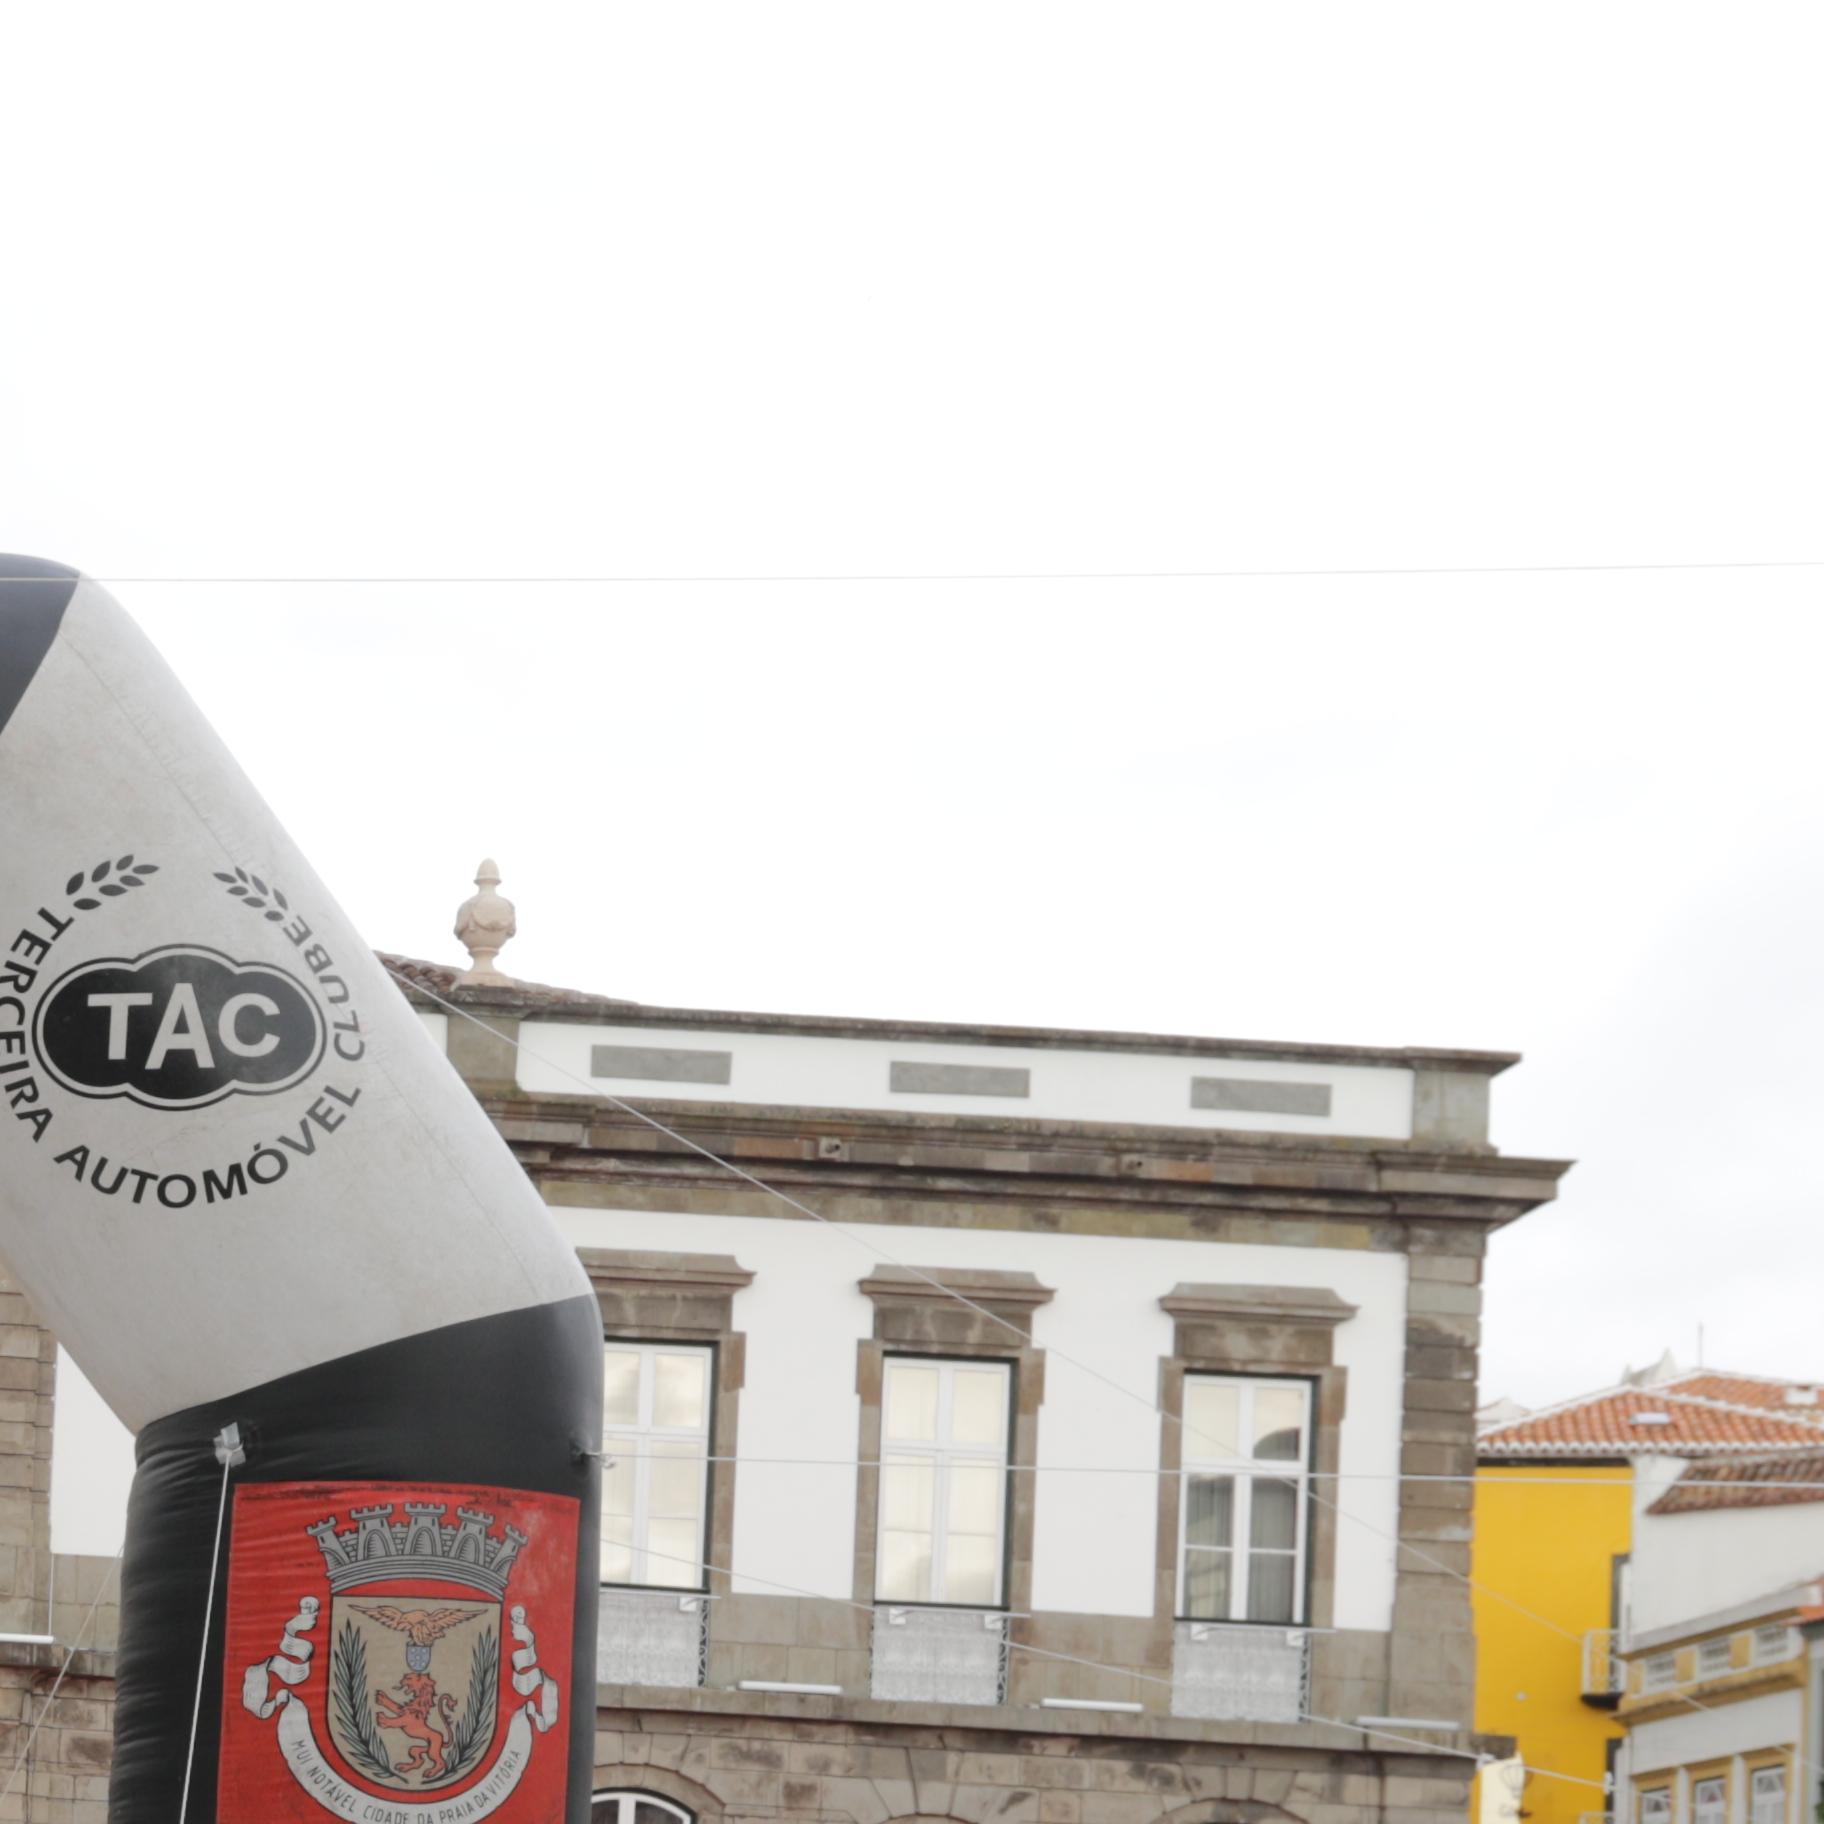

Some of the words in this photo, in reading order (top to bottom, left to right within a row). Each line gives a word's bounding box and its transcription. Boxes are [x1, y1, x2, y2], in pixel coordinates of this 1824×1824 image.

[53, 1084, 362, 1209] AUTOMÓVEL
[282, 914, 366, 1063] CLUBE
[86, 982, 281, 1071] TAC
[474, 1791, 491, 1811] DA
